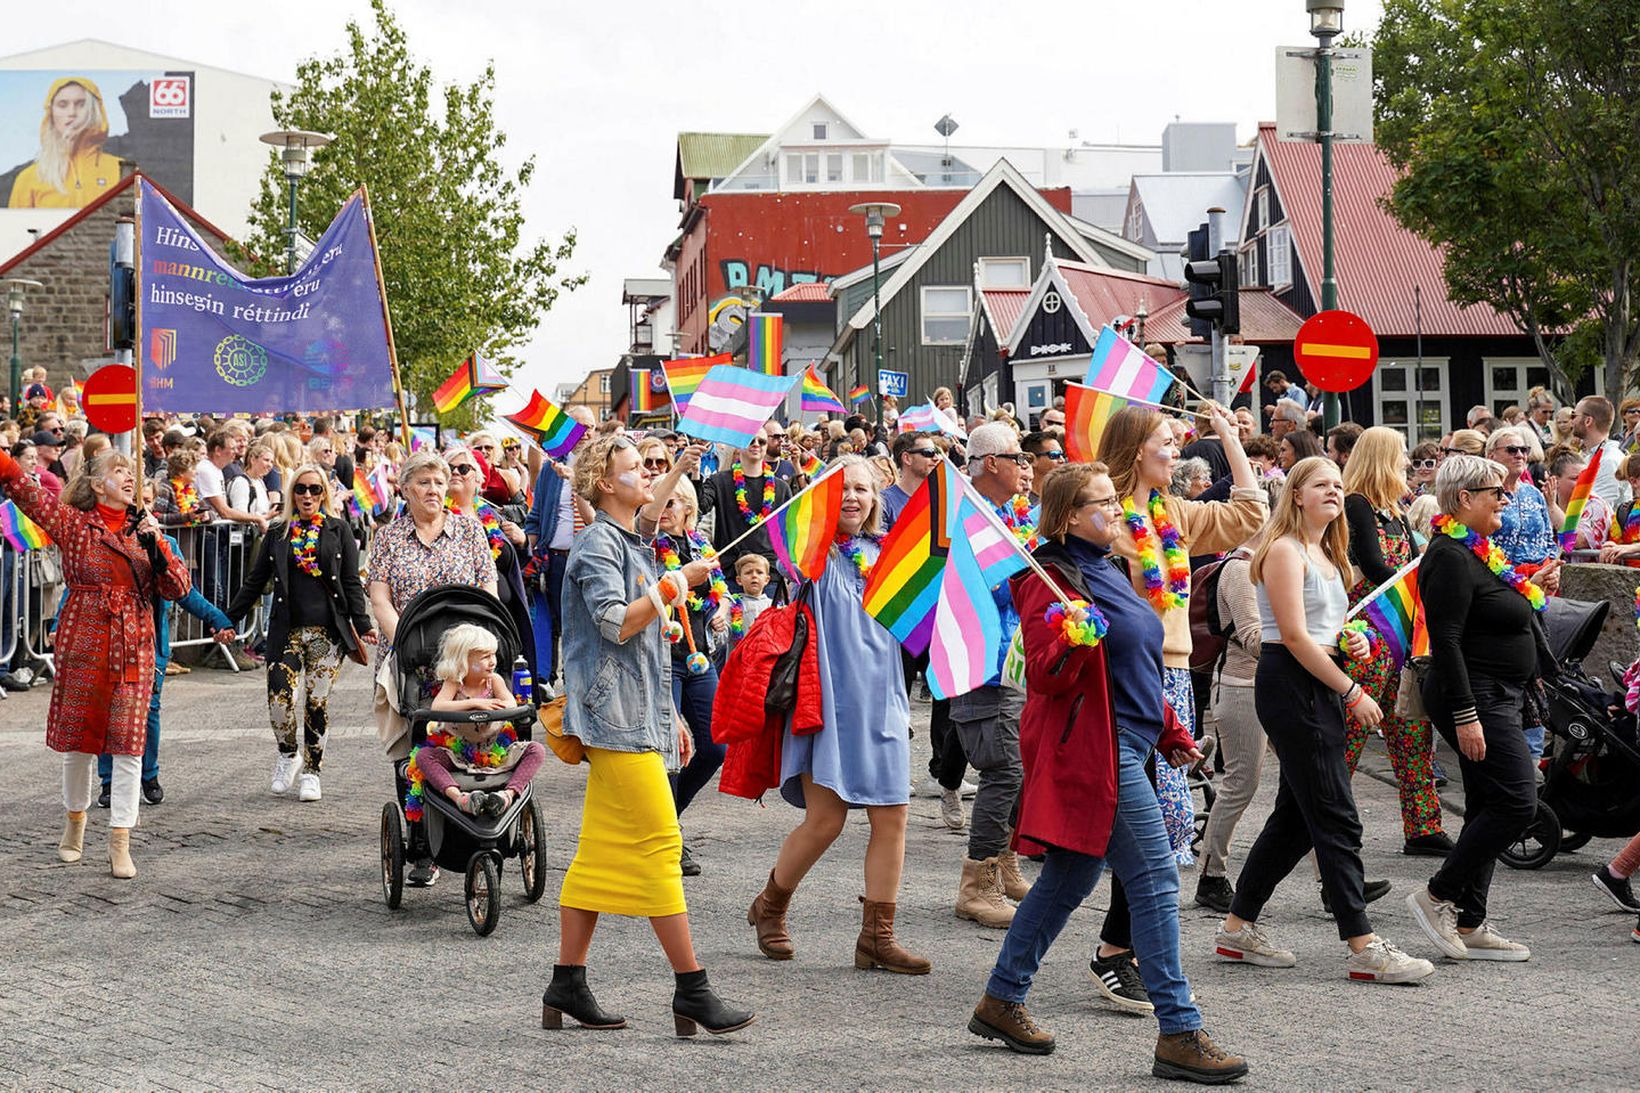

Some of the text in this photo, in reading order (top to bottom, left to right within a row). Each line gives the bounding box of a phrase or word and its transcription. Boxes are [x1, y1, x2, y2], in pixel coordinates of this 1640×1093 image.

[155, 81, 185, 105] 66
[293, 279, 320, 297] eru
[151, 283, 224, 315] hinsegin
[233, 302, 311, 323] réttindi
[880, 373, 905, 388] TAXI
